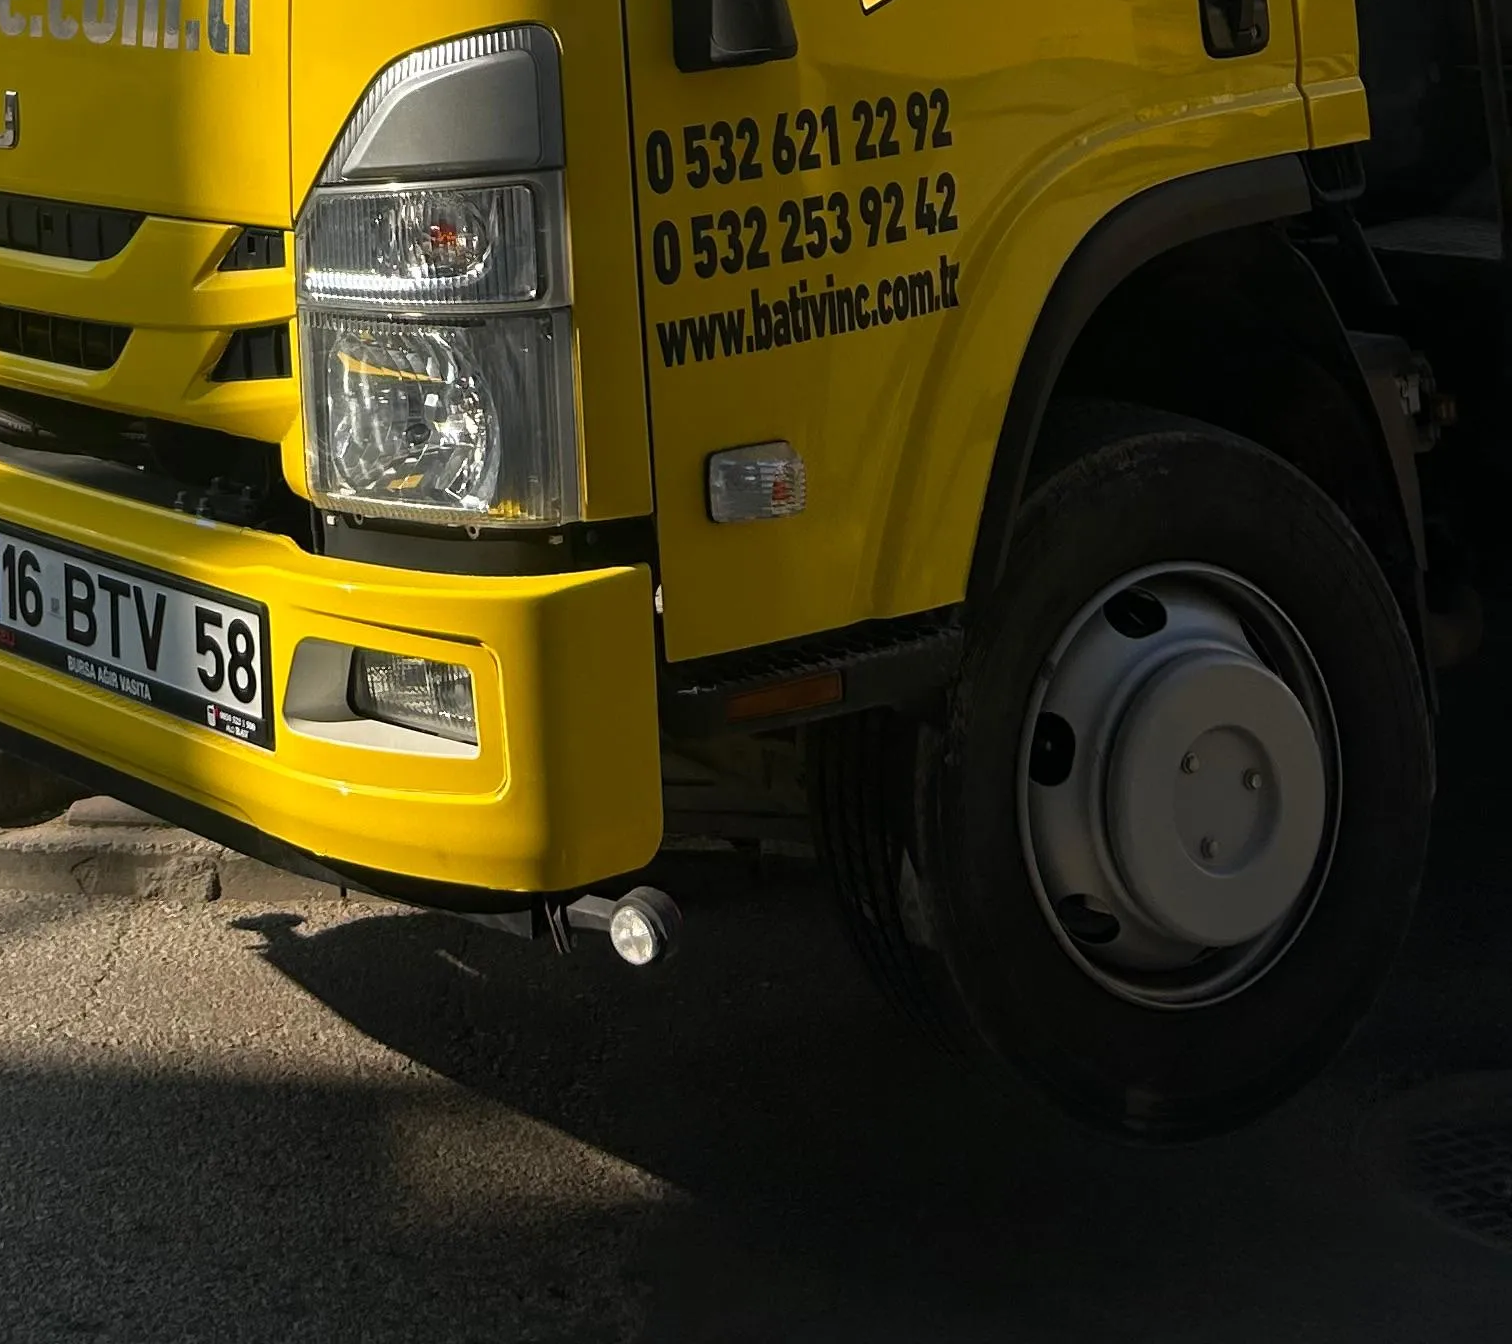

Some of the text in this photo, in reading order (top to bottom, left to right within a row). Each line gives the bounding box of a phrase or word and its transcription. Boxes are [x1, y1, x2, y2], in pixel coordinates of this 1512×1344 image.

[646, 88, 953, 194] 0 532 621 22 92
[653, 171, 959, 285] 0 532 253 92 42
[656, 255, 960, 368] www.bativinc.com.tr
[2, 543, 257, 704] 16 BTV 58
[67, 655, 96, 680] BURSA
[119, 674, 152, 702] VASITA
